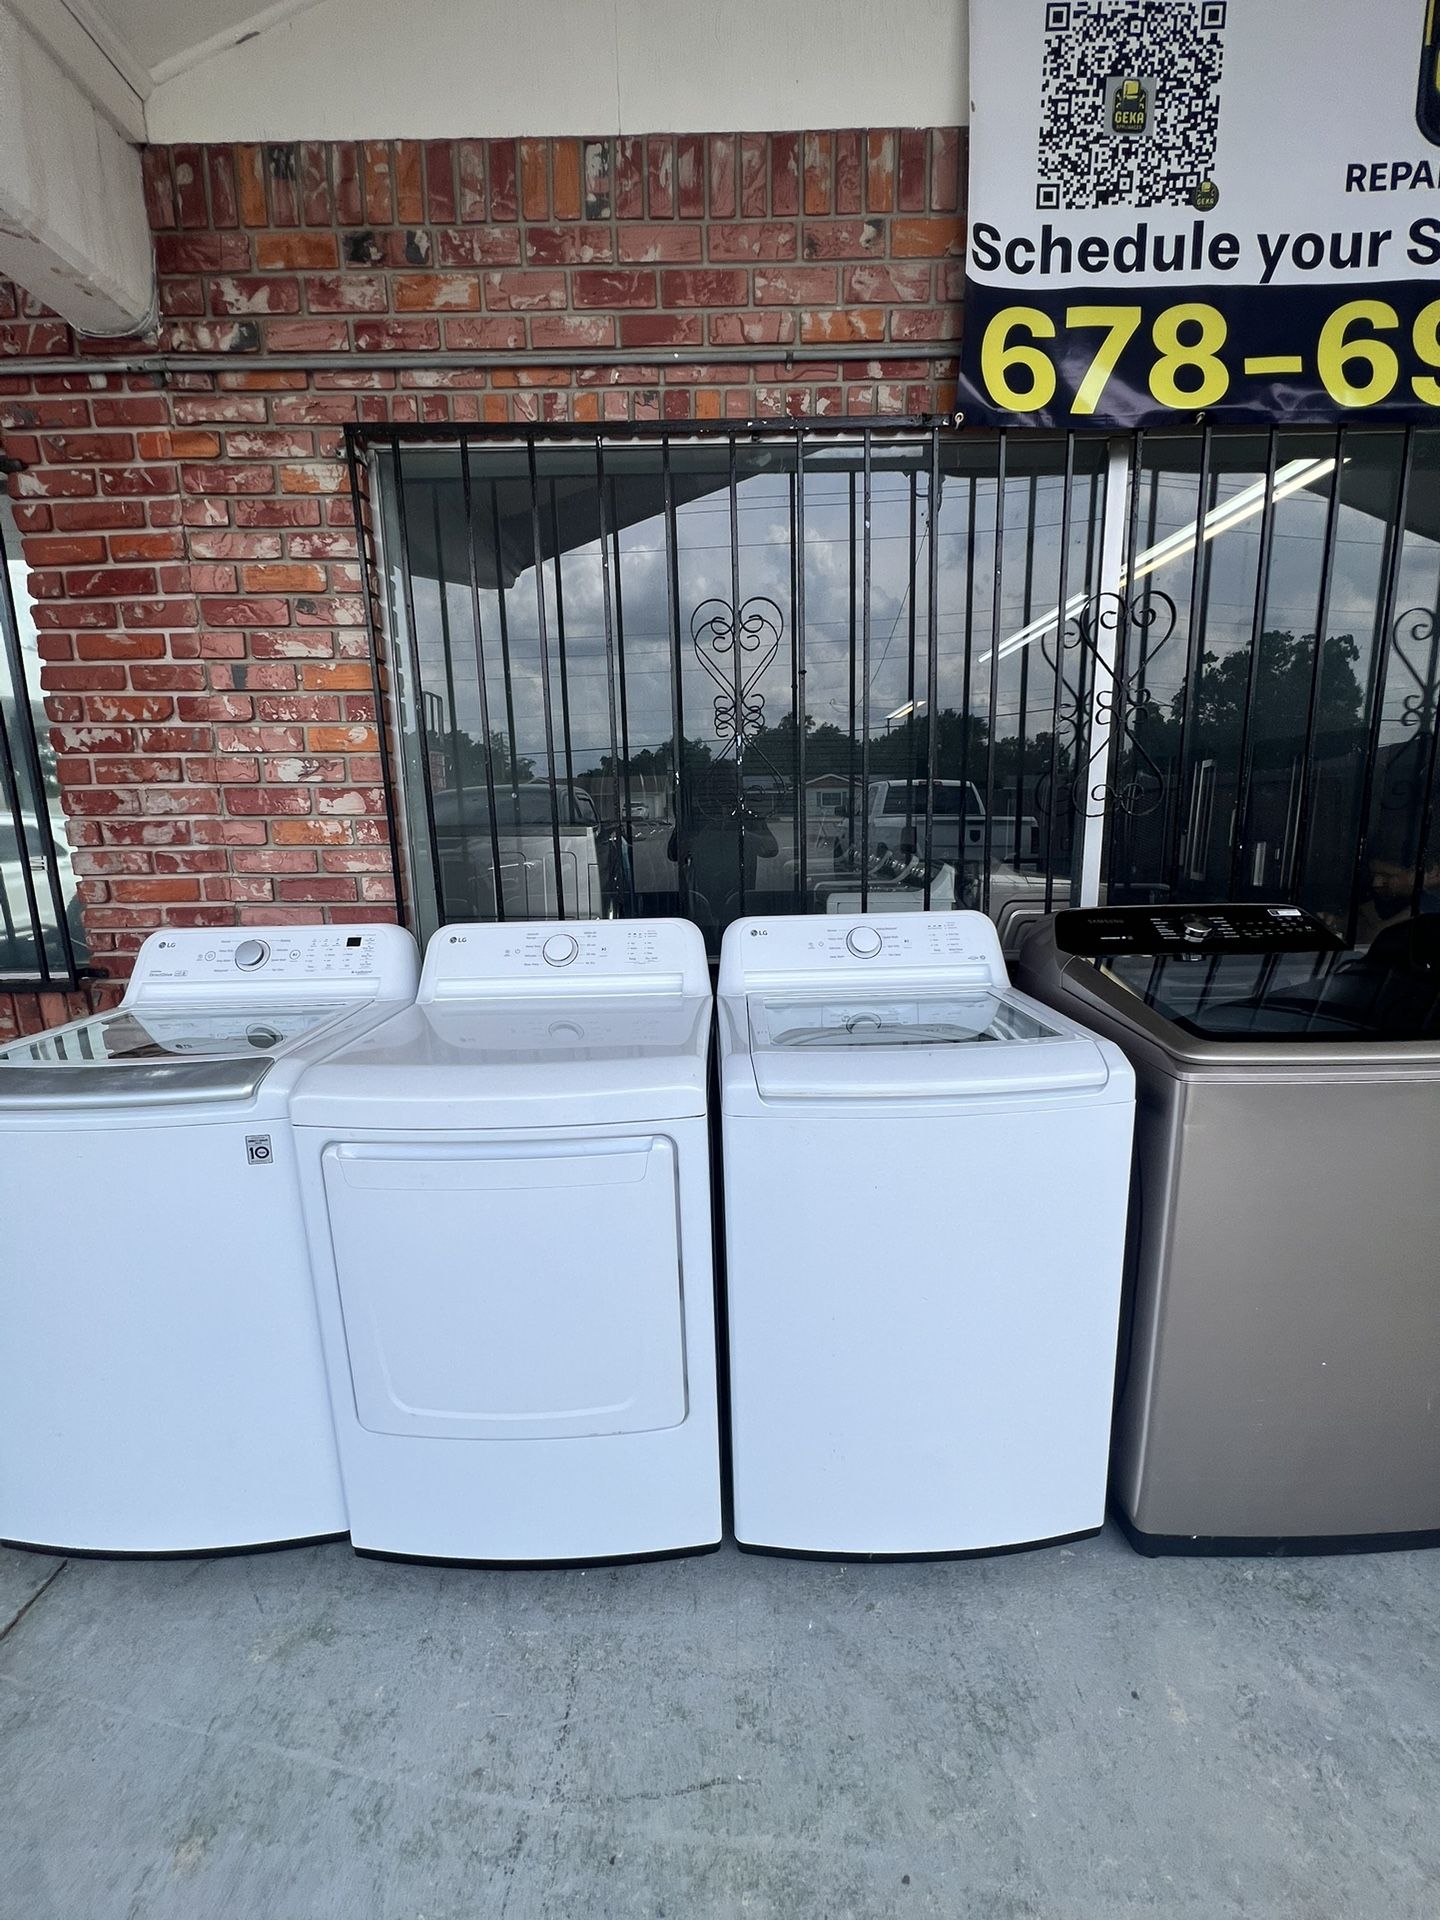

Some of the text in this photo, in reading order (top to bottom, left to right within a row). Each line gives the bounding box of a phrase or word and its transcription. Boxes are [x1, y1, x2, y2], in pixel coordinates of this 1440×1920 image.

[1115, 111, 1144, 124] GEKA
[972, 217, 1440, 284] Schedule your S
[249, 1146, 270, 1160] 10
